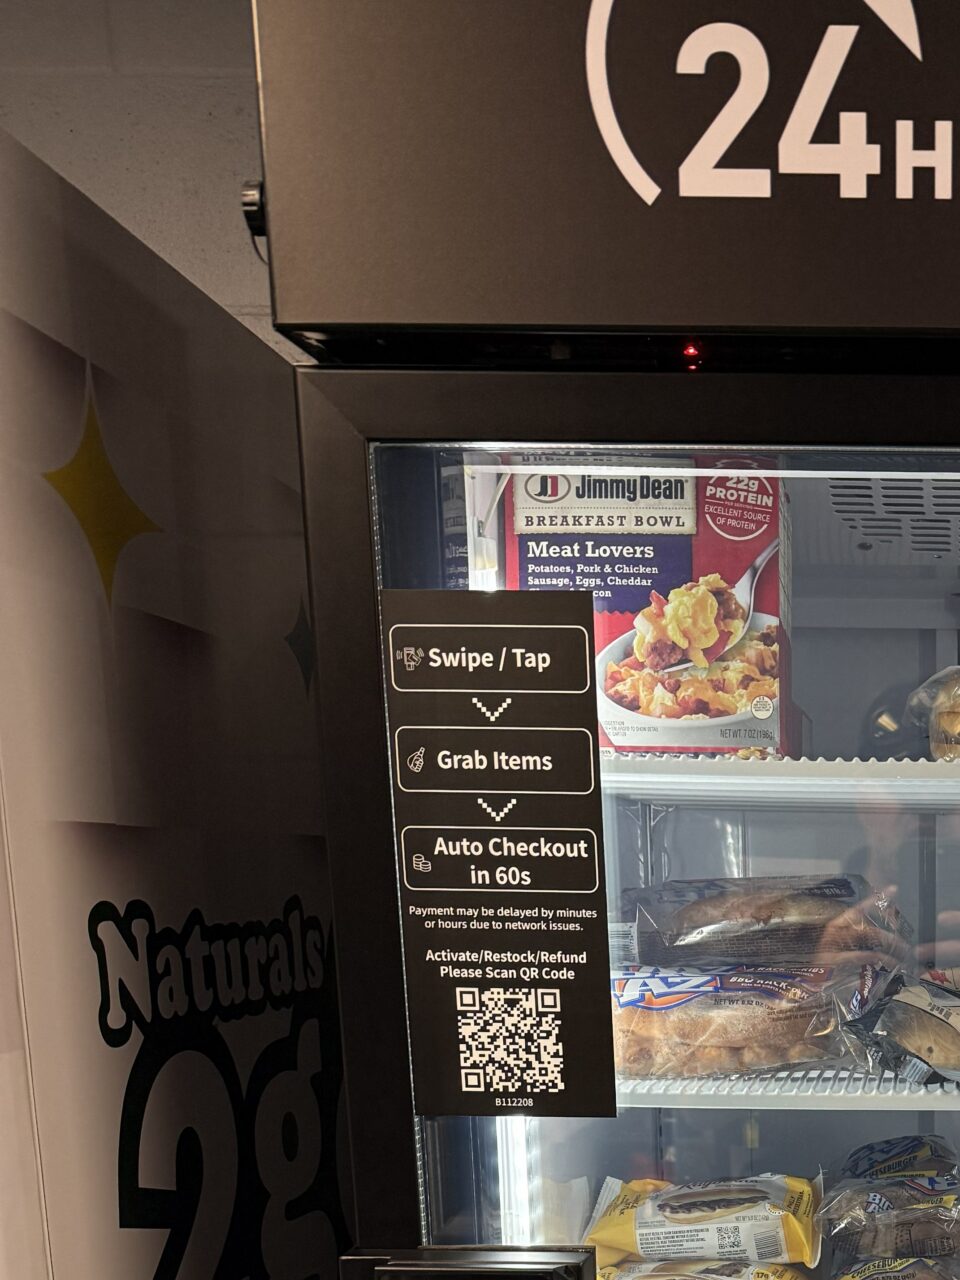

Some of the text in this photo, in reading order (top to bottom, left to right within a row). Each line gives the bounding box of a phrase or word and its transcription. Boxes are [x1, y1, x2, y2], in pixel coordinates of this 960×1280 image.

[576, 475, 685, 502] Jimmy Dean
[706, 486, 773, 506] PROTEIN
[525, 515, 685, 527] BREAKFAST BOWL
[704, 505, 742, 517] EXCELLENT
[744, 511, 770, 522] SOURCE
[716, 517, 756, 530] OF PROTEIN
[527, 541, 654, 558] Meat Lovers
[528, 564, 659, 574] Potatoes, Pork & Chicken
[528, 576, 653, 587] Sausage, Eggs, Cheddar
[428, 646, 551, 672] Swipe / Tap
[720, 729, 731, 739] NET
[437, 750, 553, 771] Grab Items
[434, 837, 588, 858] Auto Checkout
[470, 865, 532, 886] in 60s
[409, 905, 597, 920] Payment may be delayed by minutes
[425, 919, 584, 931] or hours due to network issues.
[425, 949, 587, 964] Activate/Restock/Refund
[92, 898, 329, 1044] Naturals
[440, 965, 575, 981] Please Scan QR Code
[495, 1098, 533, 1107] B112208
